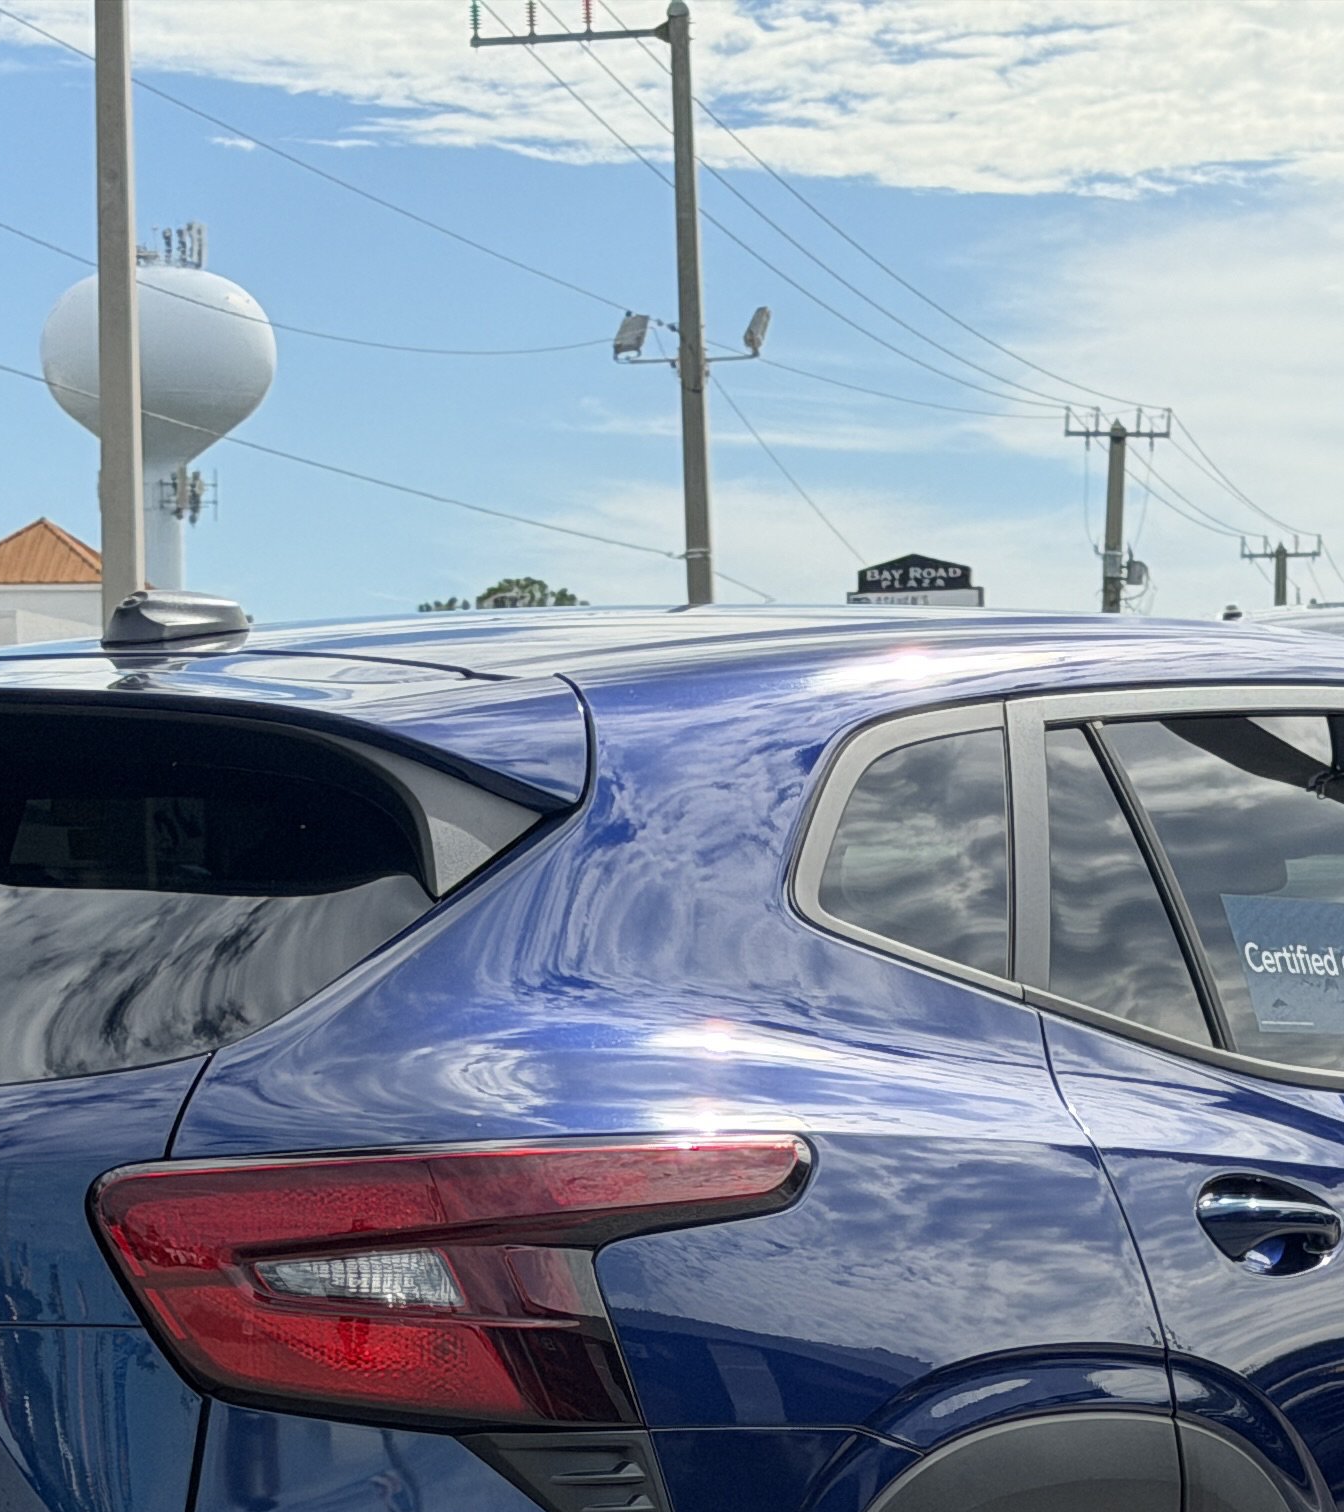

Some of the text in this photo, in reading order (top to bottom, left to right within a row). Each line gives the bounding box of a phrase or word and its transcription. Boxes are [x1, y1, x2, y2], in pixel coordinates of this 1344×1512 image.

[866, 567, 962, 581] BAY ROAD
[881, 579, 946, 589] PLAZA
[1244, 942, 1339, 976] Certified
